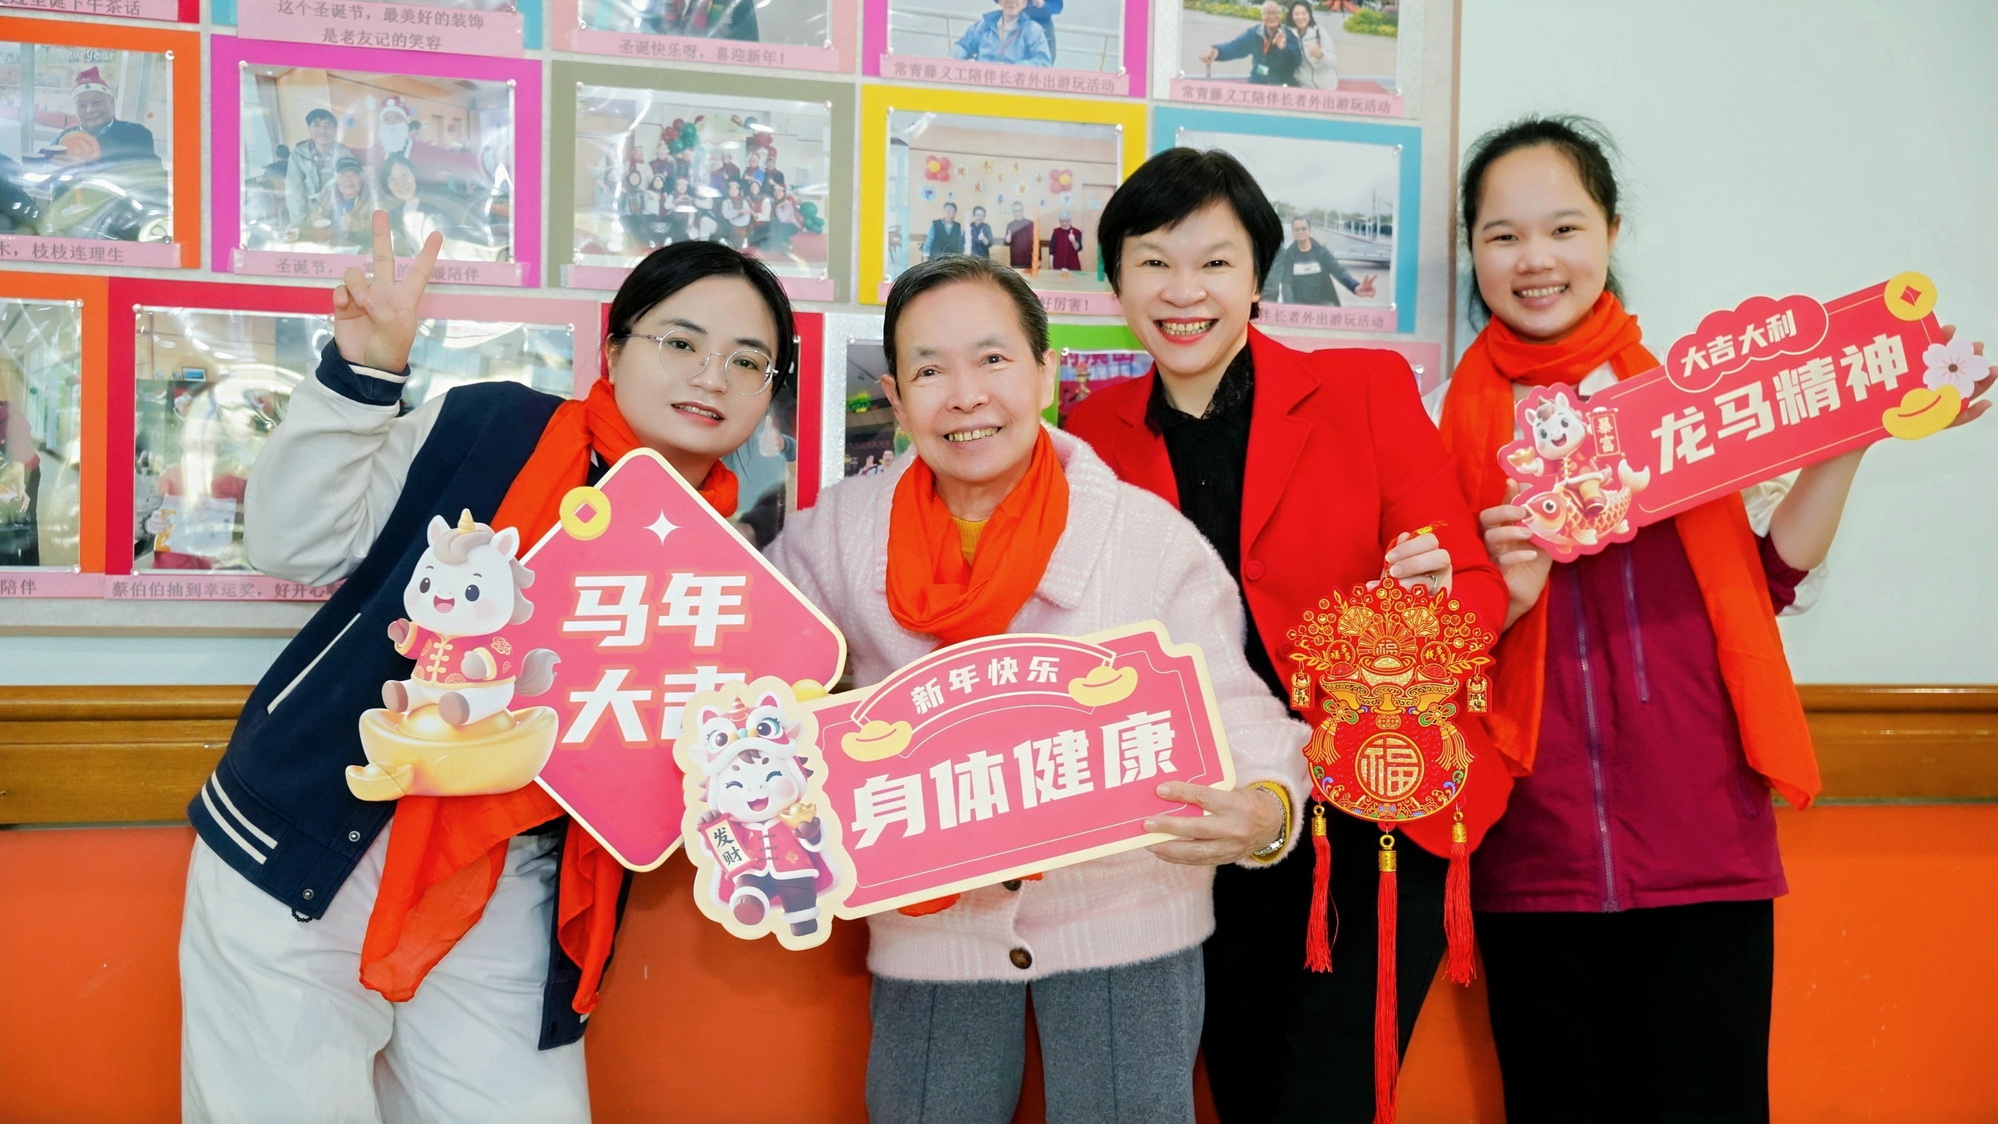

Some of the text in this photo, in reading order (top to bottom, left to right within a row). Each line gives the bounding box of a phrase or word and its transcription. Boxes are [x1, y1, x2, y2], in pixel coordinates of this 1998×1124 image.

[277, 0, 485, 30] 这个圣诞节，最美好的装饰
[322, 27, 442, 50] 是老友记的笑容
[619, 38, 785, 64] 圣诞快乐呀，喜迎新年！
[893, 62, 1115, 94] 常青藤义工陪伴长者外出游玩活动
[1181, 84, 1392, 115] 常青藤义工陪伴长者外出游玩活动
[1681, 309, 1797, 378] 大吉大利
[1651, 333, 1909, 475] 龙马精神
[111, 580, 336, 599] 蔡伯伯抽到幸运奖，好开心
[562, 572, 746, 645] 马年
[909, 655, 1060, 715] 新年快乐
[851, 710, 1178, 850] 身体健康
[1361, 737, 1419, 797] 福
[713, 827, 743, 867] 发财
